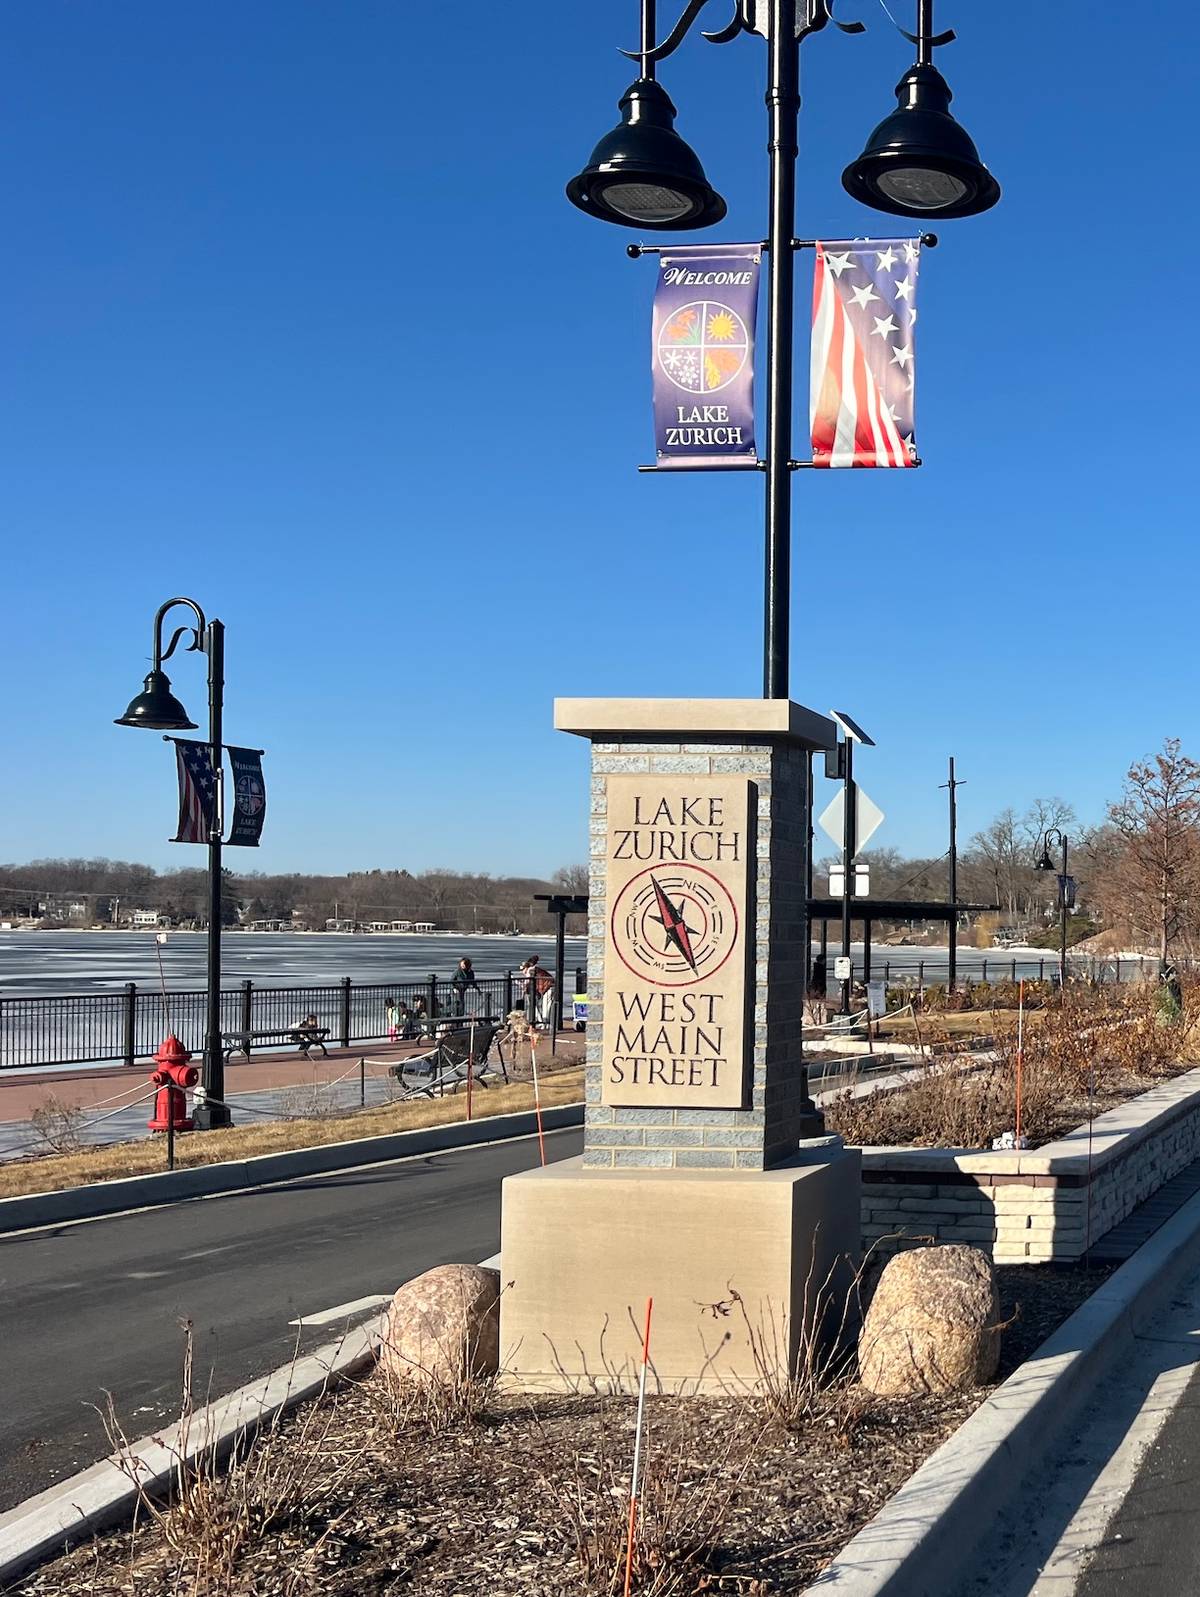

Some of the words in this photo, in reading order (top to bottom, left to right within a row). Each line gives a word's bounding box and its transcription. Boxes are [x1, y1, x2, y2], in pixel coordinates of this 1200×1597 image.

[663, 267, 753, 286] WELCOME
[677, 405, 729, 424] LAKE
[665, 427, 743, 446] ZURICH
[633, 796, 724, 827] LAKE
[613, 830, 740, 861] ZURICH
[682, 879, 698, 891] NE
[616, 991, 724, 1024] WEST
[614, 1023, 724, 1056] MAIN
[610, 1056, 727, 1087] STREET
